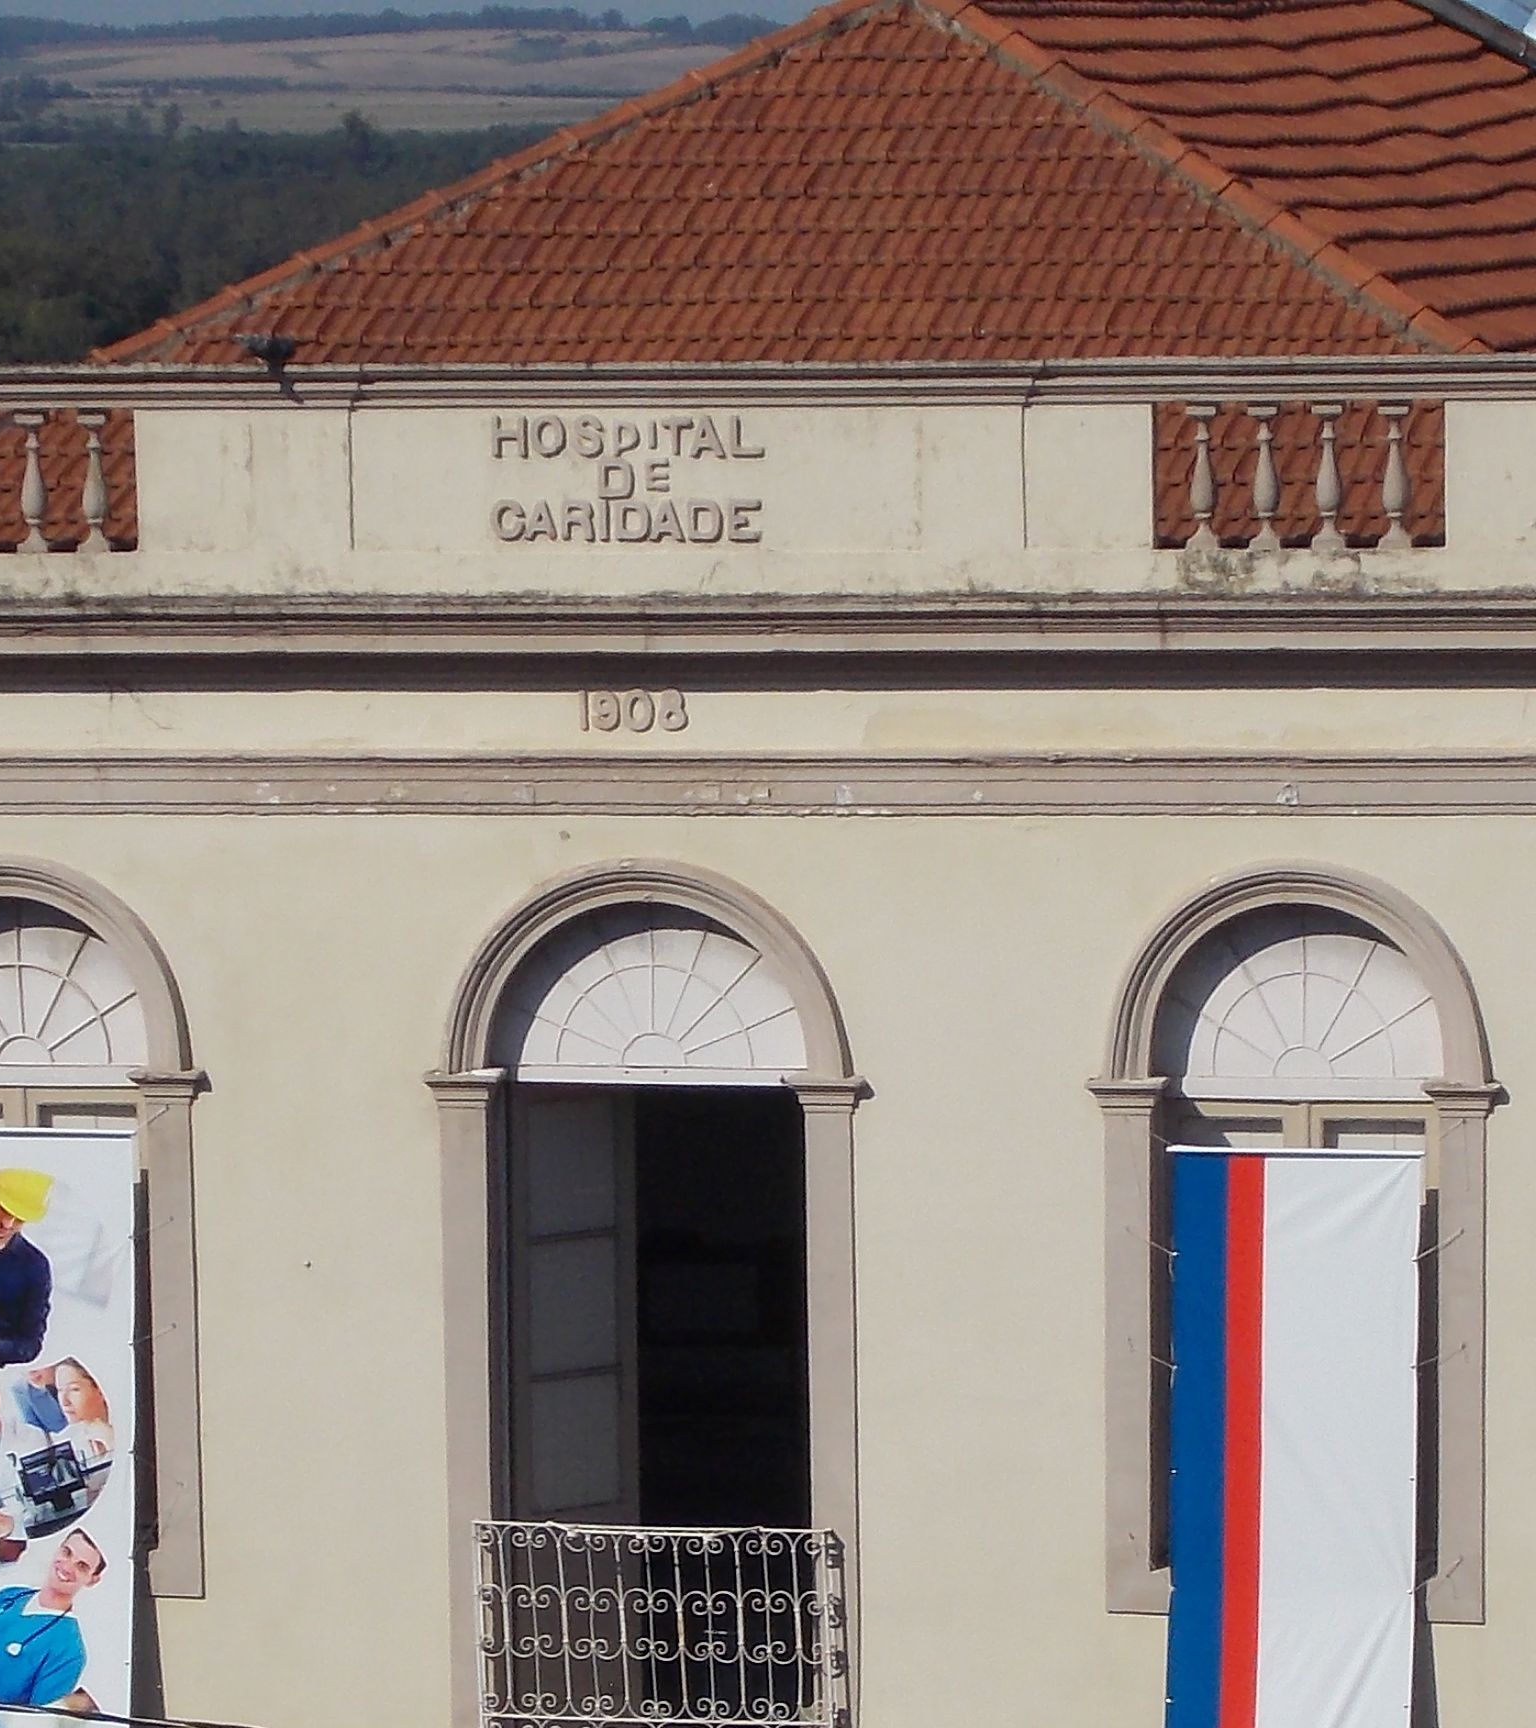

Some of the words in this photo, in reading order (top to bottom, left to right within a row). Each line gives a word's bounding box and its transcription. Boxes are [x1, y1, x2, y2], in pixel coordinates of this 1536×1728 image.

[491, 415, 765, 459] HOSPITAL
[598, 457, 670, 500] DE
[490, 499, 762, 543] CARIDADE
[578, 689, 689, 732] 1908
